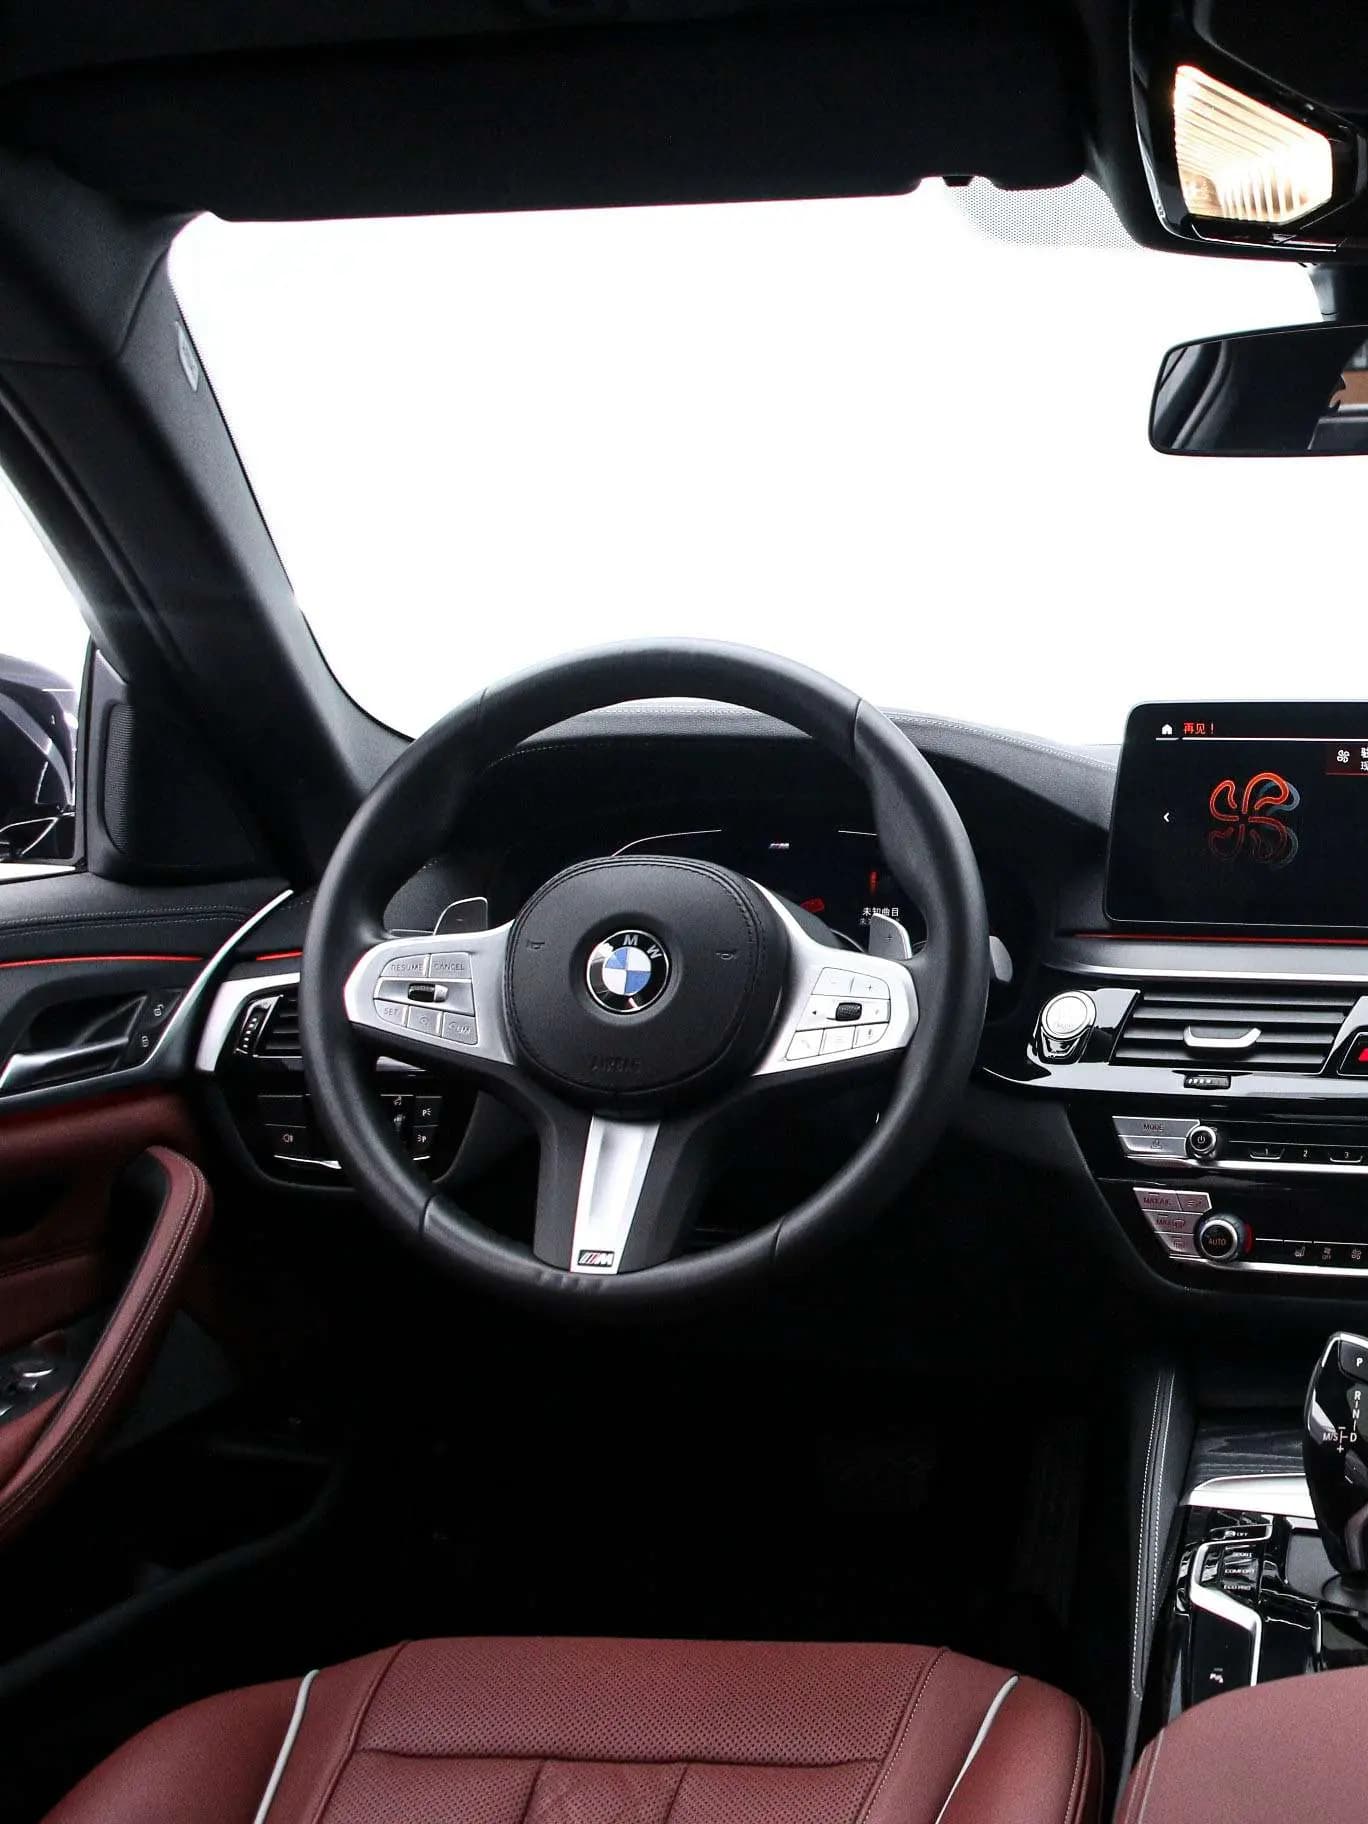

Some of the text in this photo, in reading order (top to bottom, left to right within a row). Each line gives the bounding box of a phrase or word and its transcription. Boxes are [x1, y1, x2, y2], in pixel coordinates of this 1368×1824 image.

[391, 962, 465, 972] RESUME CANCEL
[383, 1007, 398, 1016] SET
[1143, 1123, 1164, 1131] MODE
[1208, 1238, 1226, 1246] AUTO
[1356, 1357, 1363, 1367] P
[1354, 1391, 1361, 1401] R
[1352, 1409, 1360, 1419] N
[1322, 1432, 1339, 1442] M/S
[1349, 1432, 1357, 1442] D
